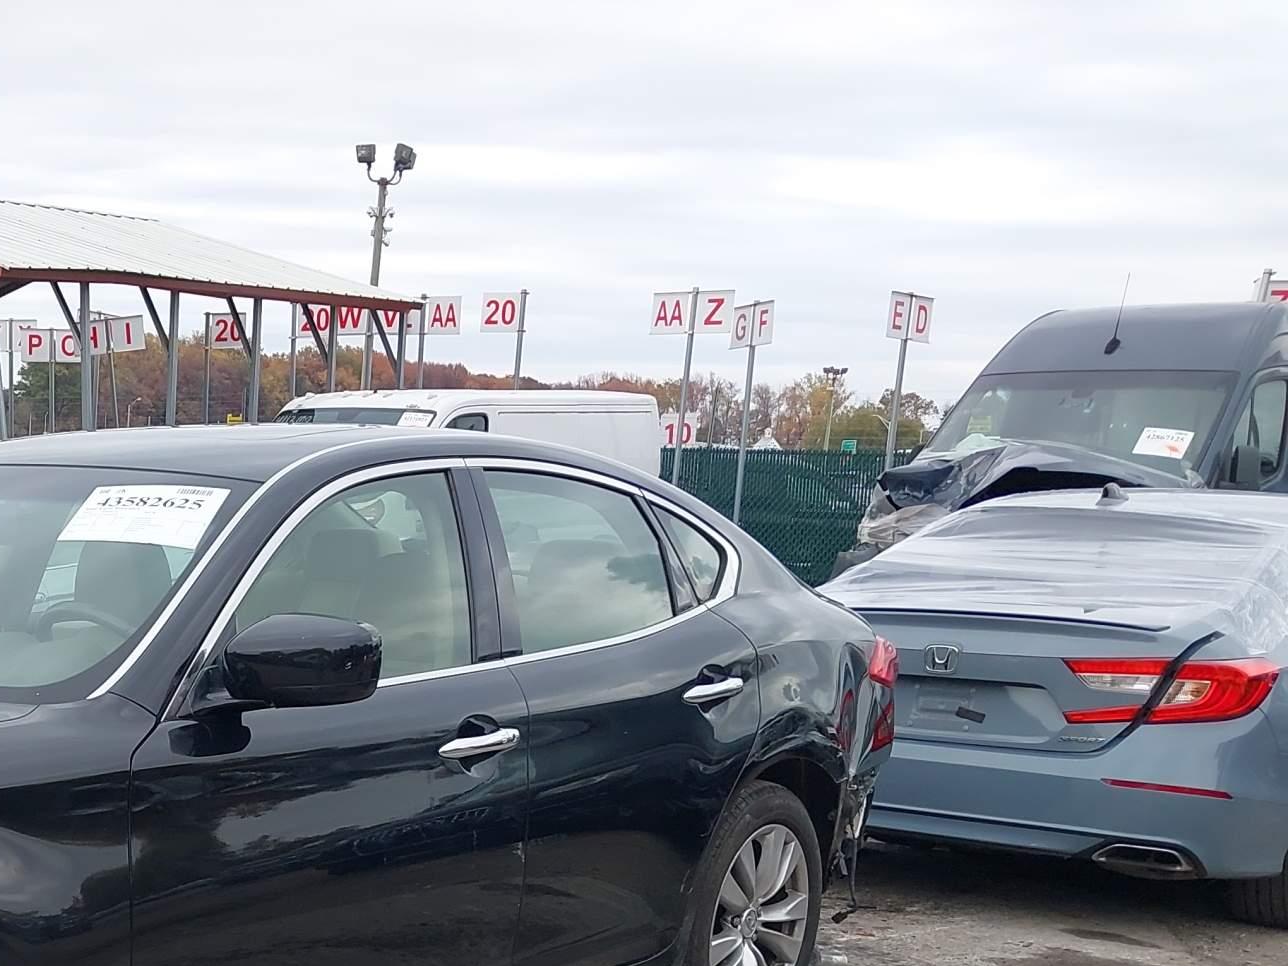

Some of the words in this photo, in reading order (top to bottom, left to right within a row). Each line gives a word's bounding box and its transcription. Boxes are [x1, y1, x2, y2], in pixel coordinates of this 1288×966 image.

[337, 306, 363, 329] W
[383, 309, 398, 328] V
[431, 303, 457, 328] AA
[484, 299, 516, 325] 20
[654, 299, 683, 327] AA
[703, 298, 725, 326] Z
[758, 309, 769, 338] F
[892, 300, 905, 330] E
[915, 304, 928, 334] D
[215, 319, 242, 343] 20
[735, 313, 747, 341] G
[28, 334, 43, 356] P
[665, 422, 692, 445] 10
[97, 496, 206, 511] 43582625
